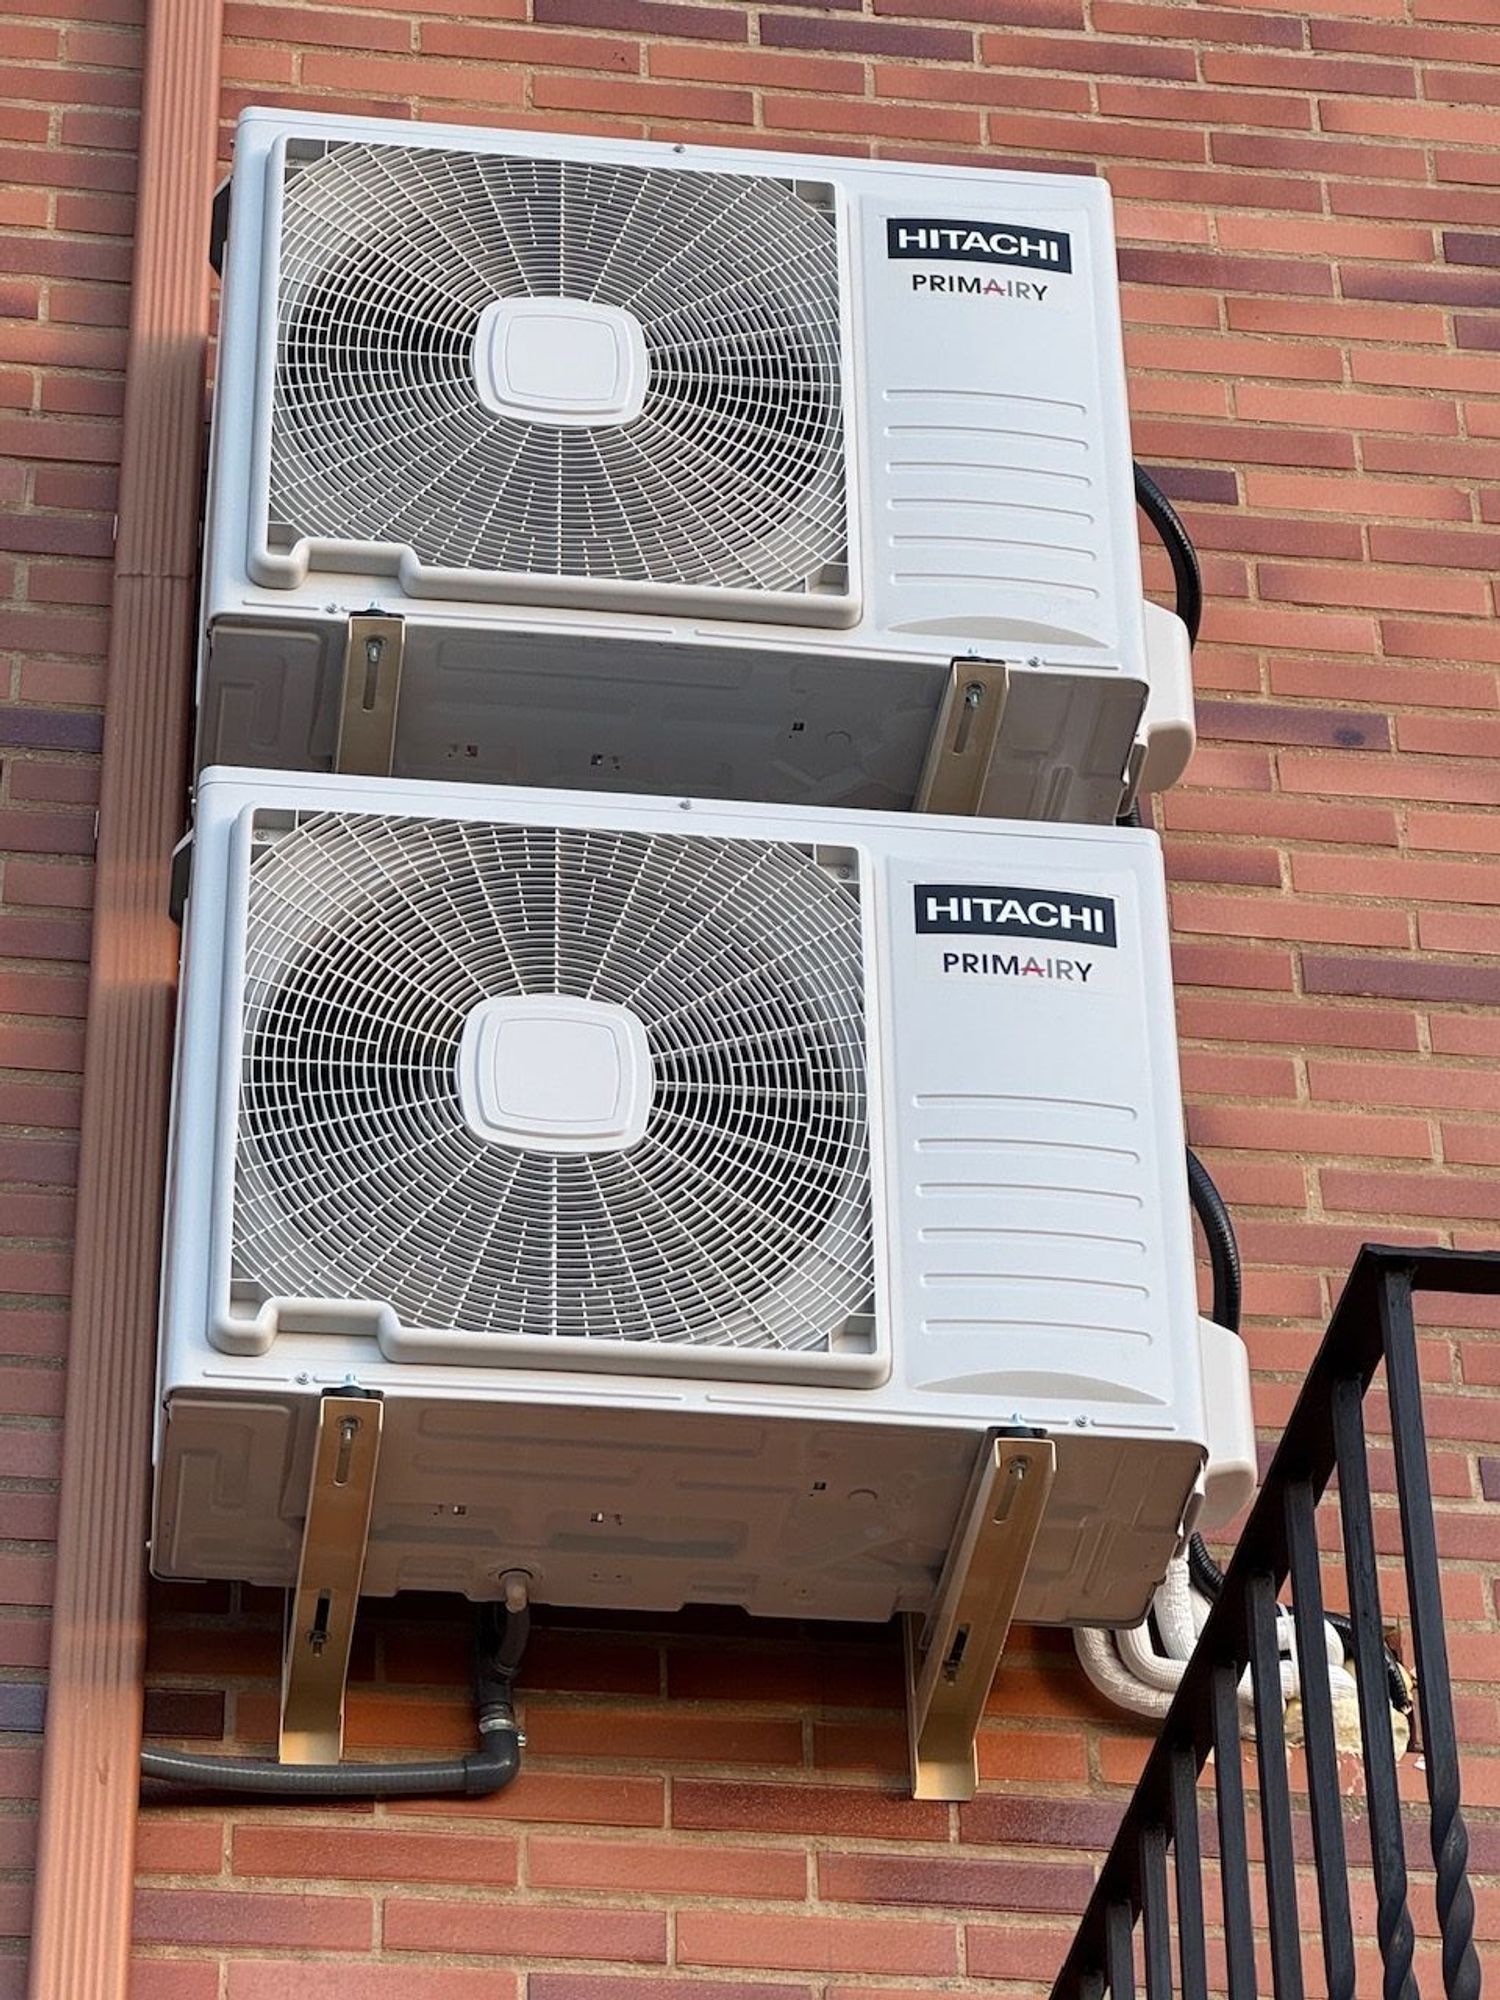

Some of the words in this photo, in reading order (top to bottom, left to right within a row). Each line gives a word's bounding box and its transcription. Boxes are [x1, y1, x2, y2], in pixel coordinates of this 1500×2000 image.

[898, 228, 1060, 262] HITACHI
[912, 274, 1048, 301] PRIMAIRY
[926, 897, 1105, 933] HITACHI
[943, 952, 1092, 982] PRIMAIRY
